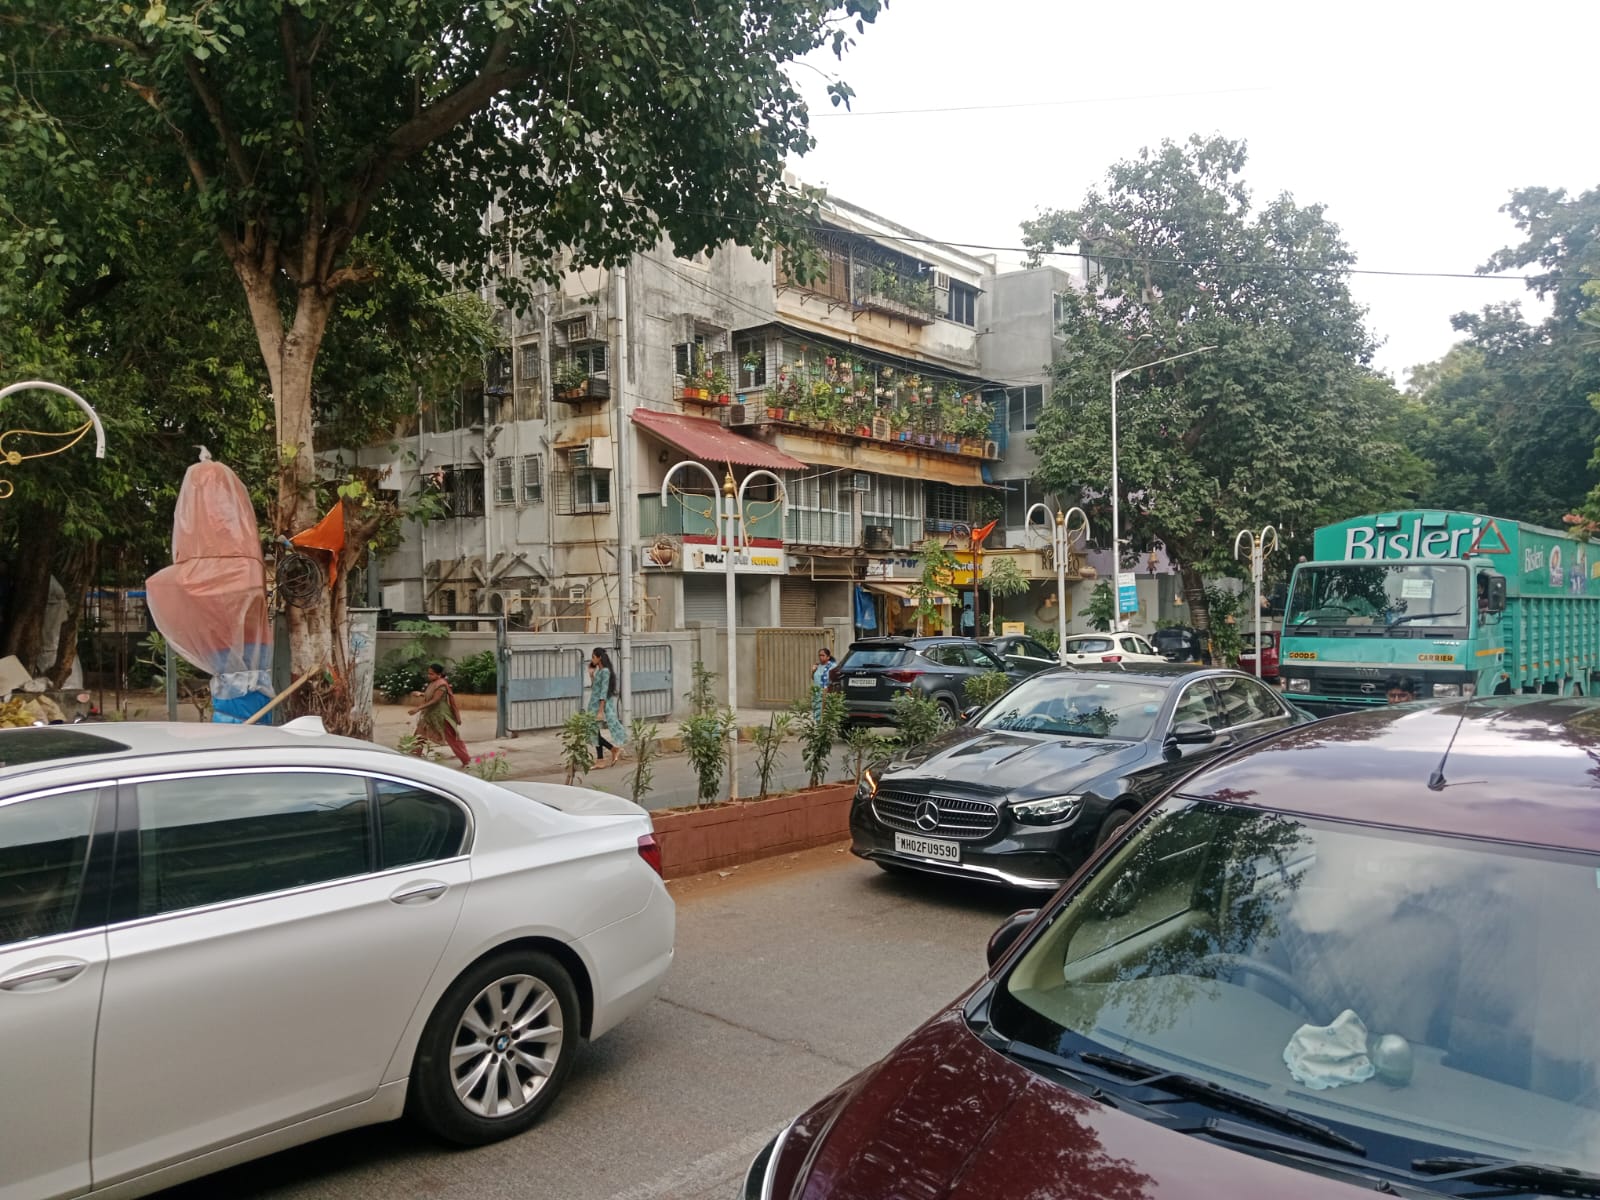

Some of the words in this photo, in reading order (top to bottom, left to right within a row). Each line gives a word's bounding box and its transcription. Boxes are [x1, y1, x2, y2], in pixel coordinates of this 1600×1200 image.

[1344, 517, 1483, 561] Bisleri
[1524, 544, 1544, 573] Bisleri
[1418, 654, 1453, 662] CARRIER
[901, 838, 958, 858] MH02FU9590
